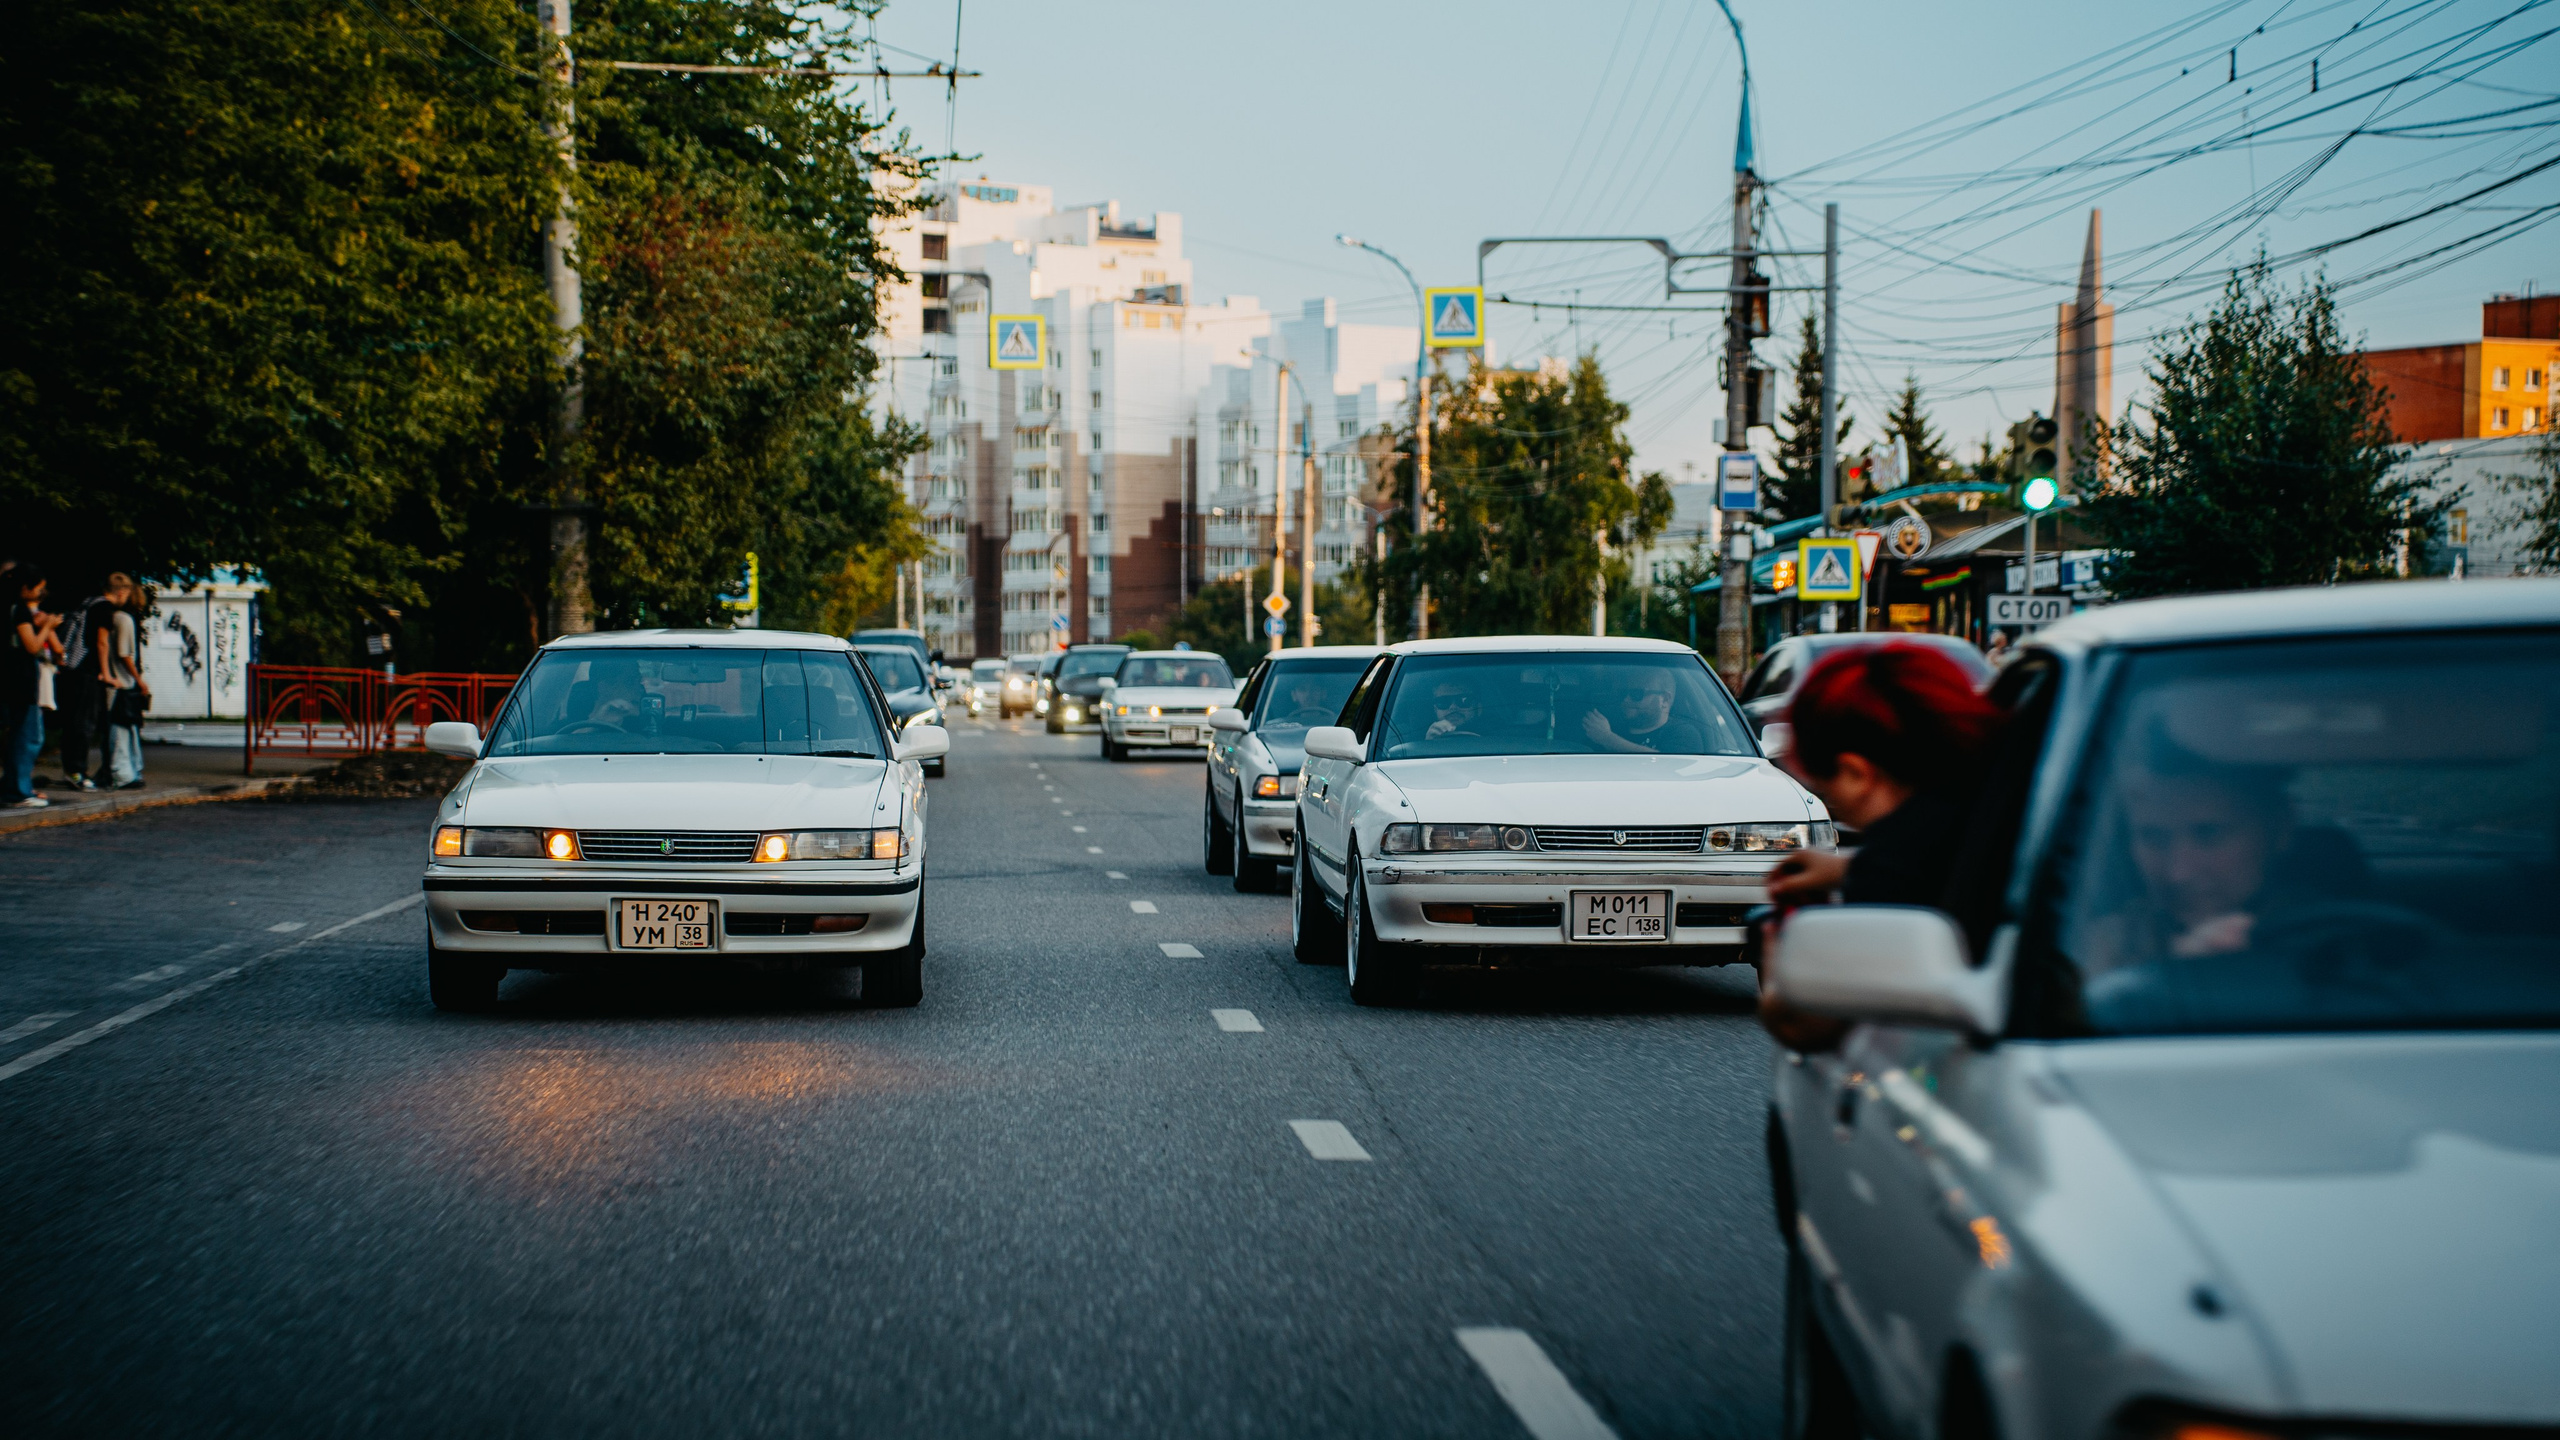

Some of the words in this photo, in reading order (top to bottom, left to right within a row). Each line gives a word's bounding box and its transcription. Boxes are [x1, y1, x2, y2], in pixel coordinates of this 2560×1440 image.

[1998, 600, 2061, 620] СТОП
[657, 904, 696, 921] 240
[1612, 896, 1649, 914] 011
[682, 926, 702, 940] 38
[1635, 918, 1660, 932] 138
[633, 926, 665, 944] УМ
